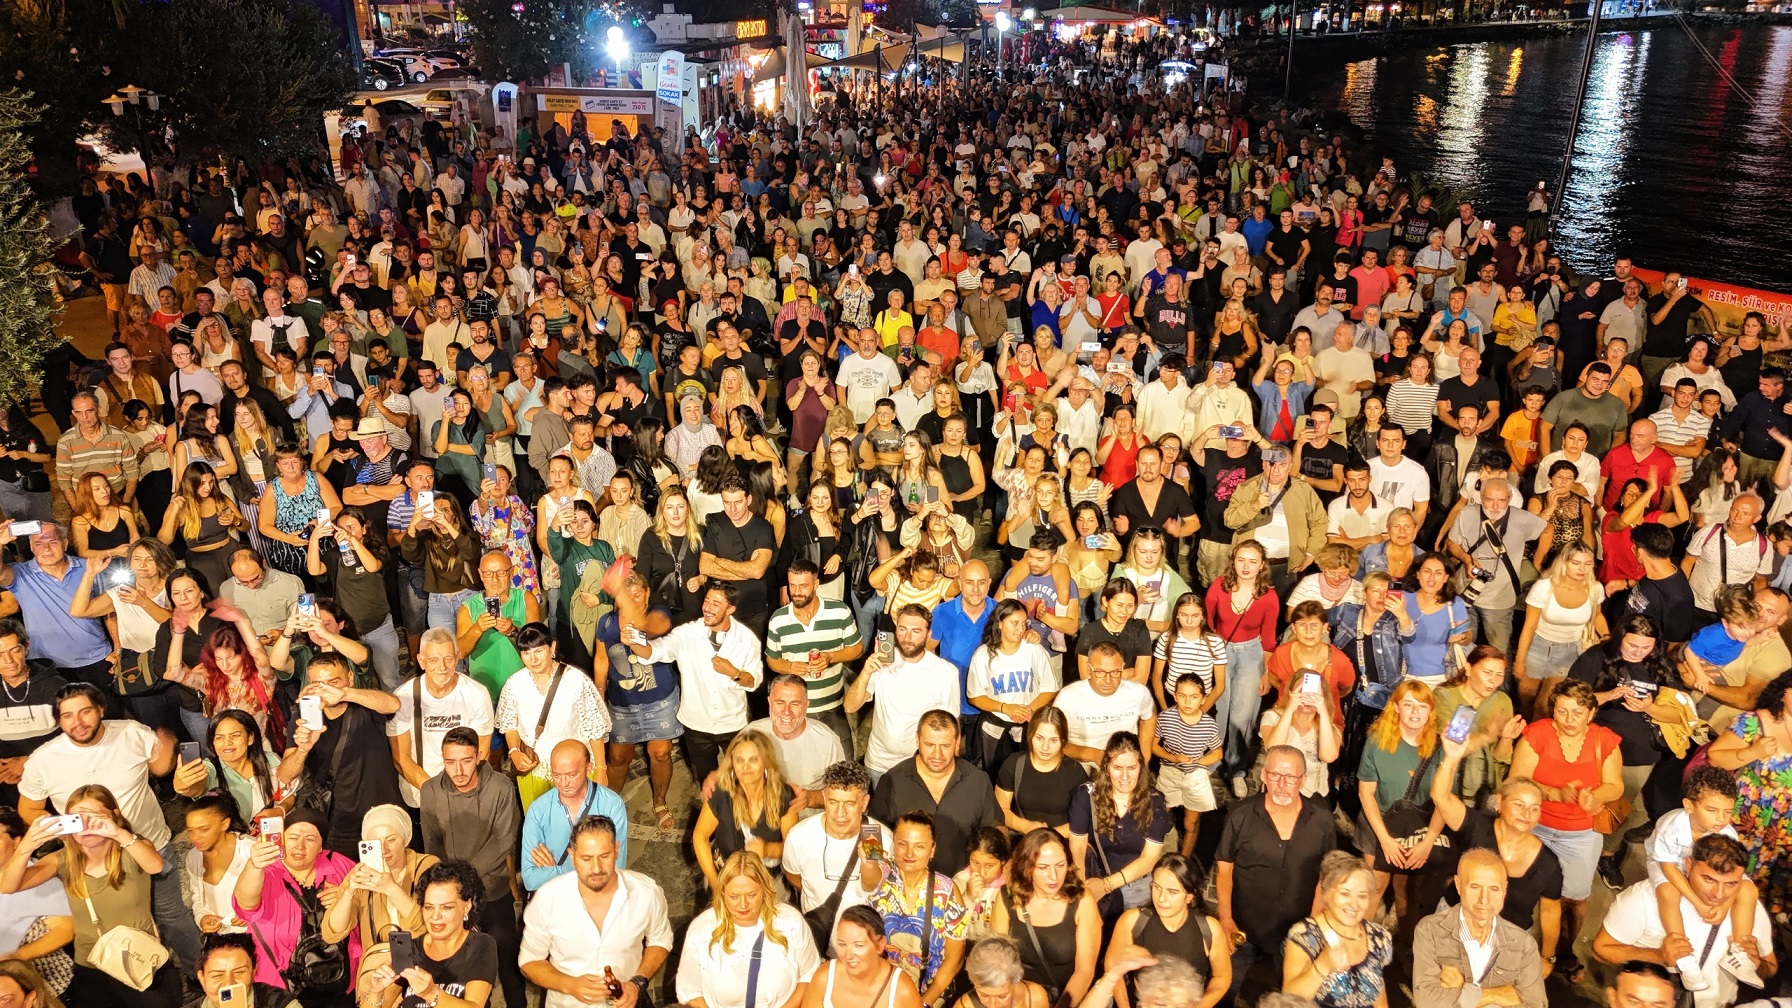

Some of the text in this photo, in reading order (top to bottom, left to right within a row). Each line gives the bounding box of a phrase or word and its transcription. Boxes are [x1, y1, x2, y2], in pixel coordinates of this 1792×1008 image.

[750, 20, 765, 37] BISTRO
[659, 90, 679, 98] SOKAK
[1708, 290, 1740, 307] RESİM,
[1742, 295, 1763, 309] ŞİİR
[1765, 302, 1776, 312] ve
[1159, 309, 1186, 326] BULLS
[1018, 583, 1058, 601] HILFIGER
